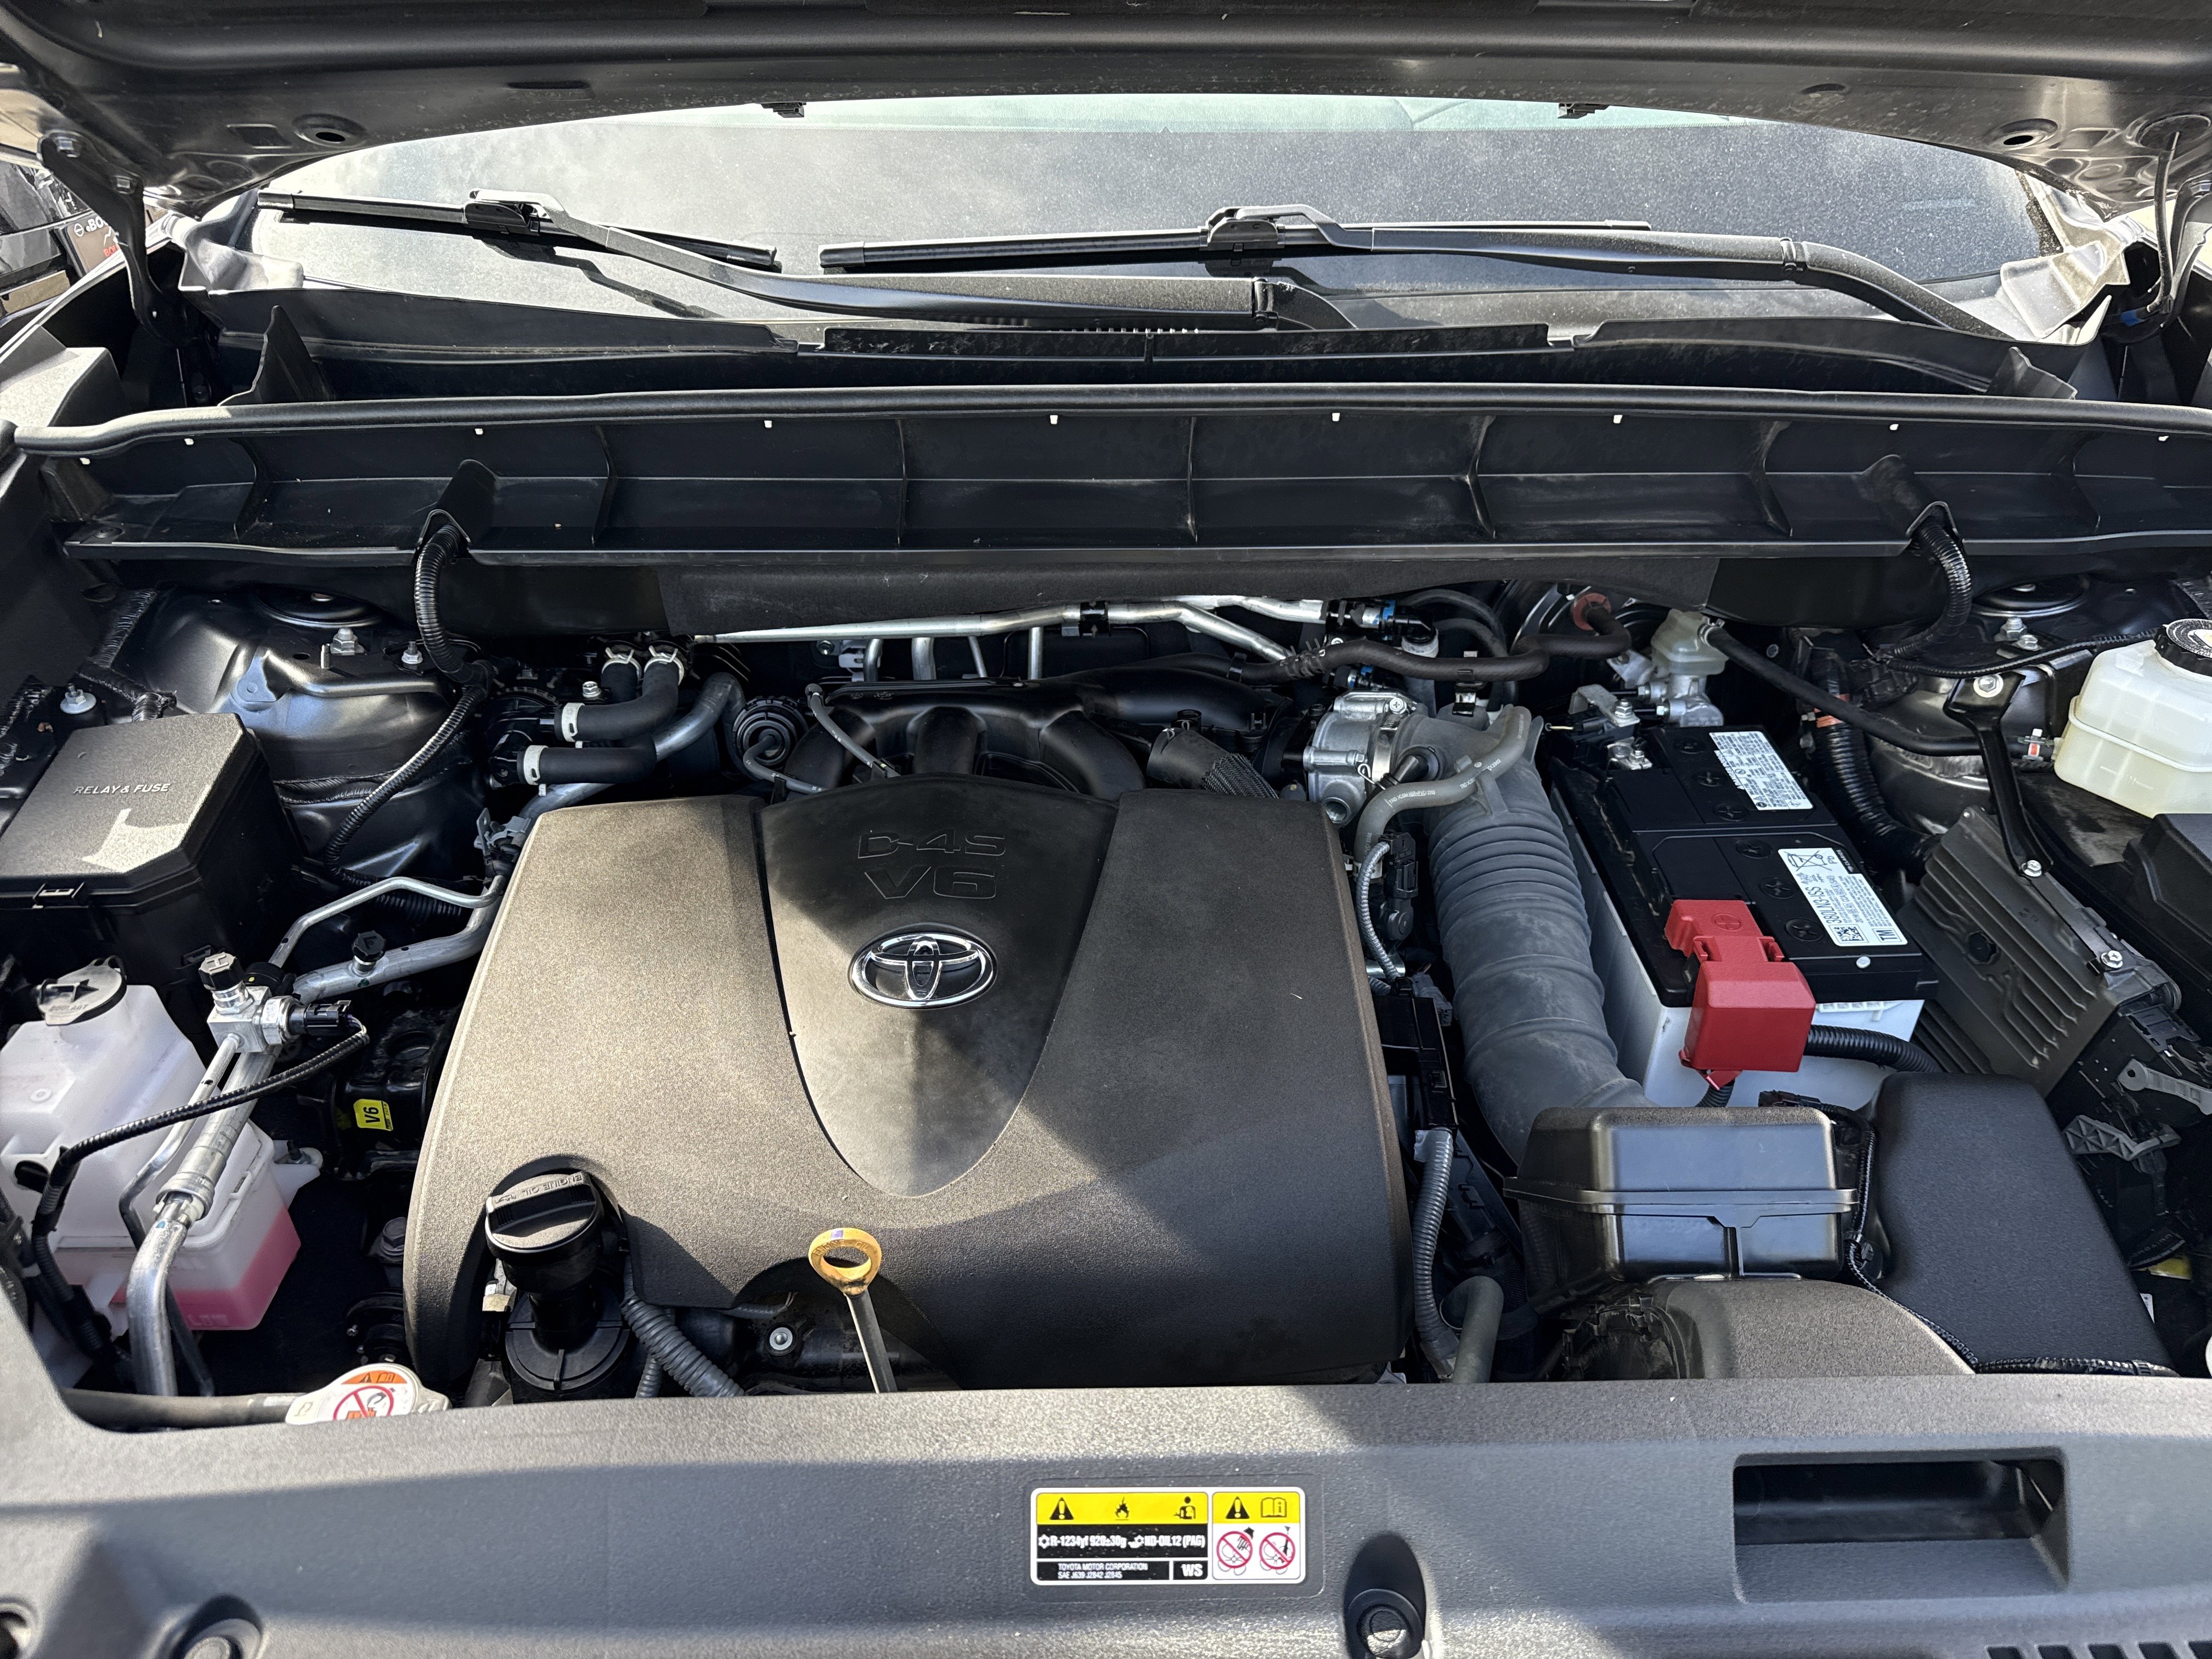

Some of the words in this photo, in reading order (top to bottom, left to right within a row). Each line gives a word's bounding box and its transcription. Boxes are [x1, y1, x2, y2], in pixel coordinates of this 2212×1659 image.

[73, 786, 121, 794] RELAY
[120, 785, 131, 793] &
[133, 783, 171, 793] FUSE
[857, 827, 1006, 860] D-4S
[1826, 855, 1837, 864] Pb
[865, 865, 997, 900] V6
[1805, 887, 1842, 923] 380LN3-ISS
[1875, 929, 1898, 940] TM
[205, 954, 229, 972] H
[363, 1106, 381, 1124] V6
[542, 1174, 582, 1191] ENGINE
[522, 1187, 539, 1196] OIL
[812, 1239, 845, 1256] ENGINE
[855, 1241, 869, 1251] OIL
[1182, 1534, 1206, 1548] (PAG)
[1058, 1562, 1082, 1571] TOYOTA
[1082, 1562, 1104, 1571] MOTOR
[1105, 1562, 1148, 1571] CORPORATION
[1181, 1564, 1203, 1577] WS
[1057, 1571, 1070, 1579] SAE
